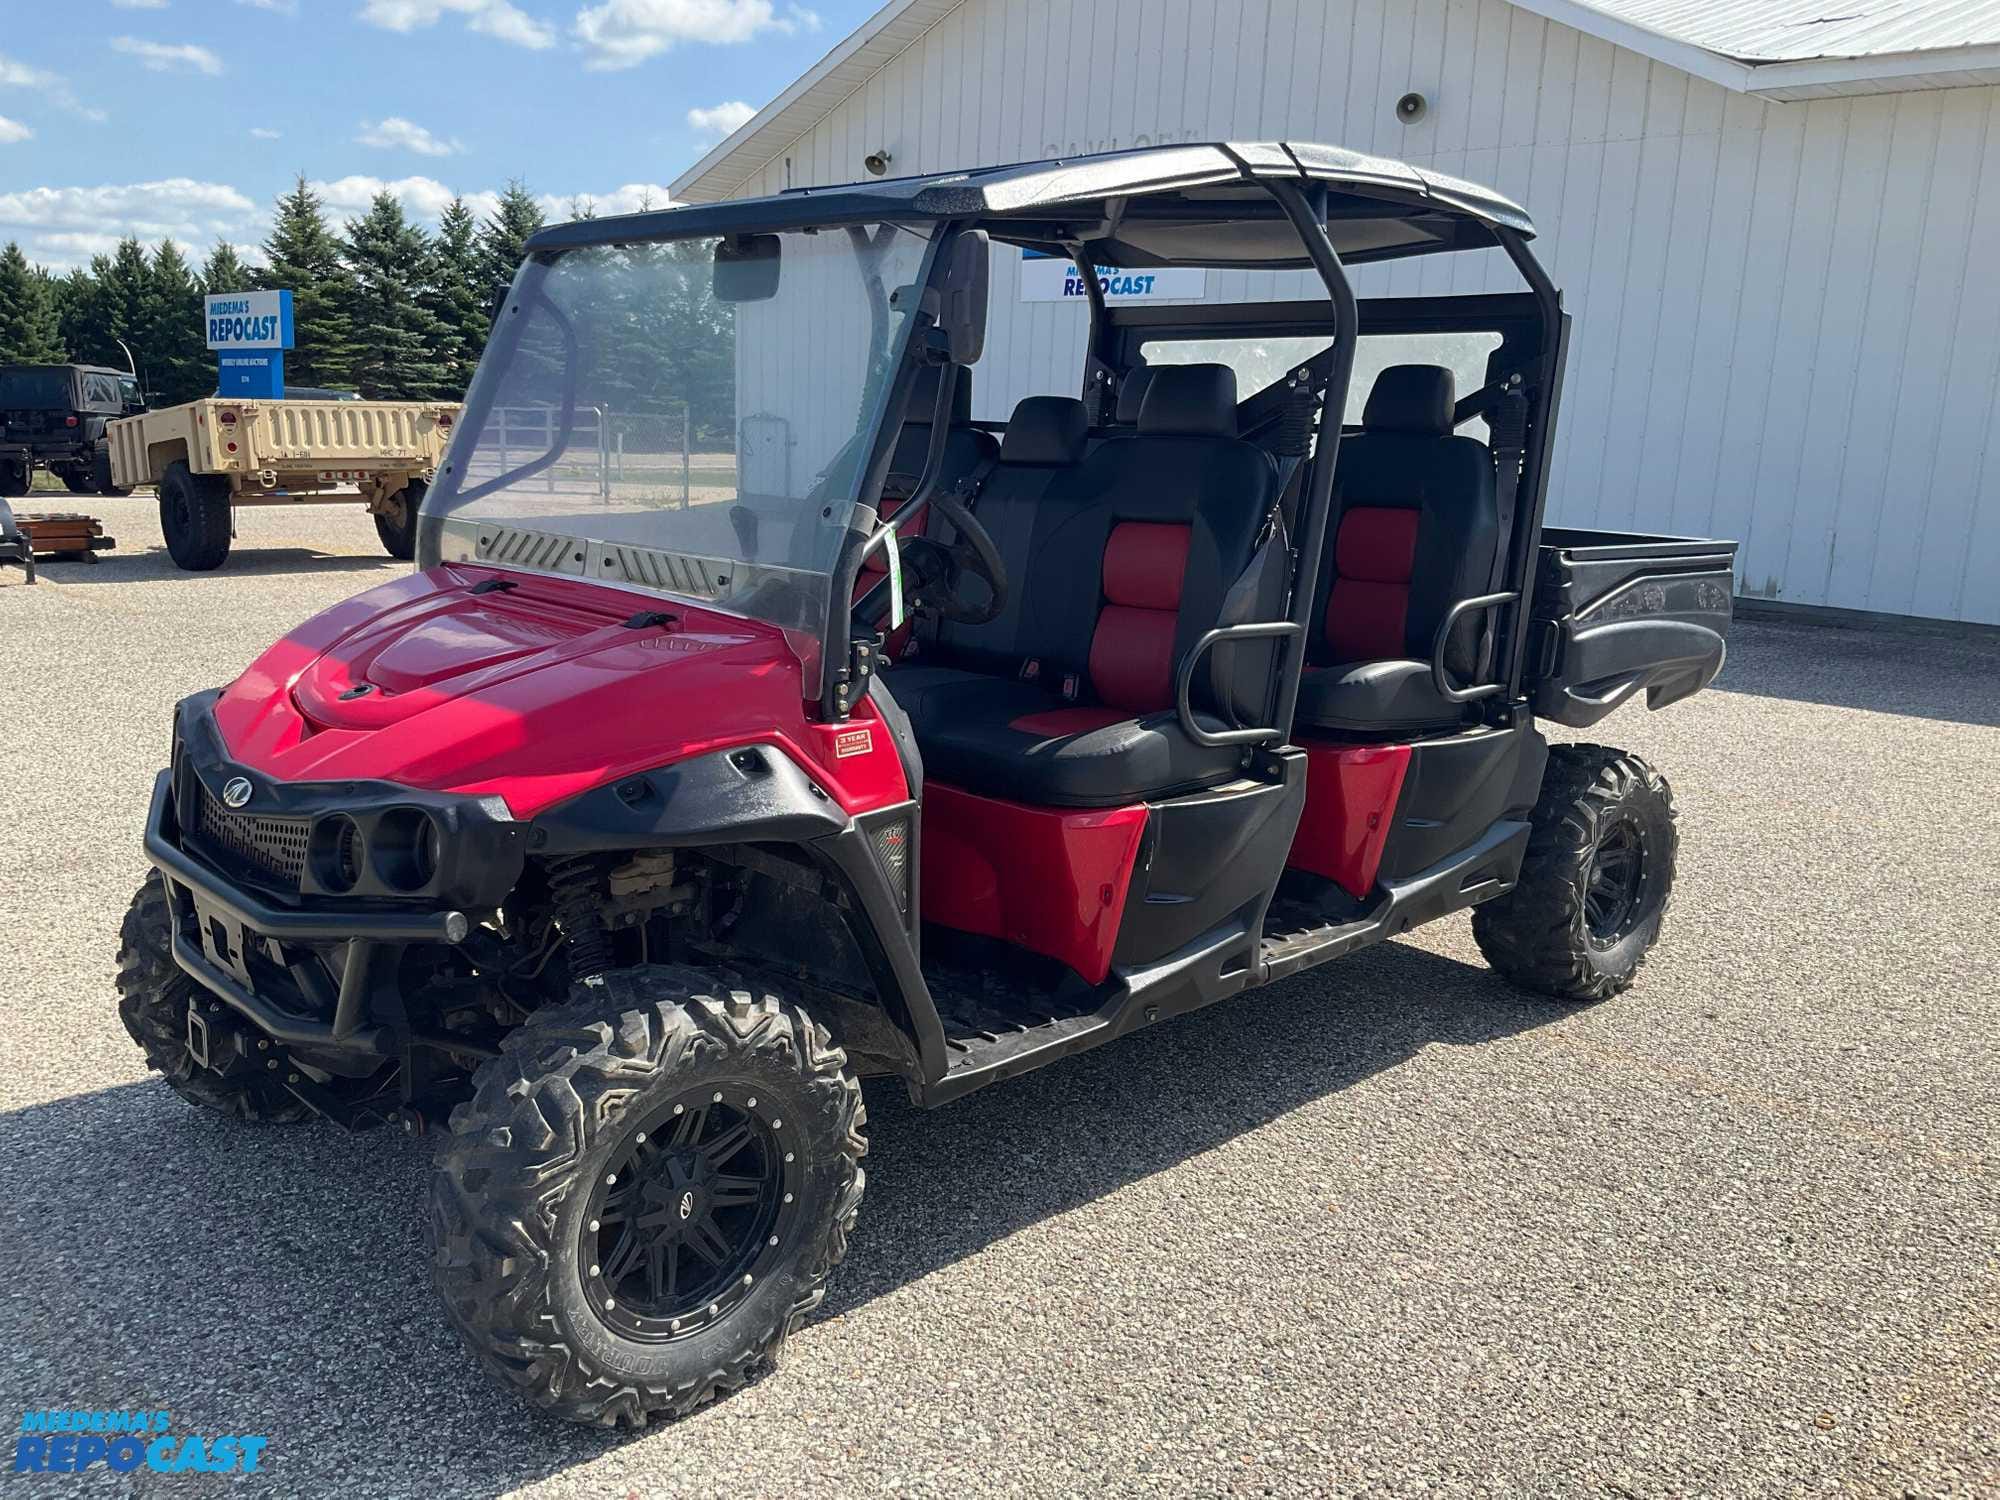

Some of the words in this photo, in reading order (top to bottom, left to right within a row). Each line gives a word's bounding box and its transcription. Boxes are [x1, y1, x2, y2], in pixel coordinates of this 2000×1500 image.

[1064, 276, 1155, 296] REOCAST
[210, 301, 249, 315] MIEDEMA'S
[209, 316, 277, 342] REPOCAST
[847, 733, 866, 742] YEAR
